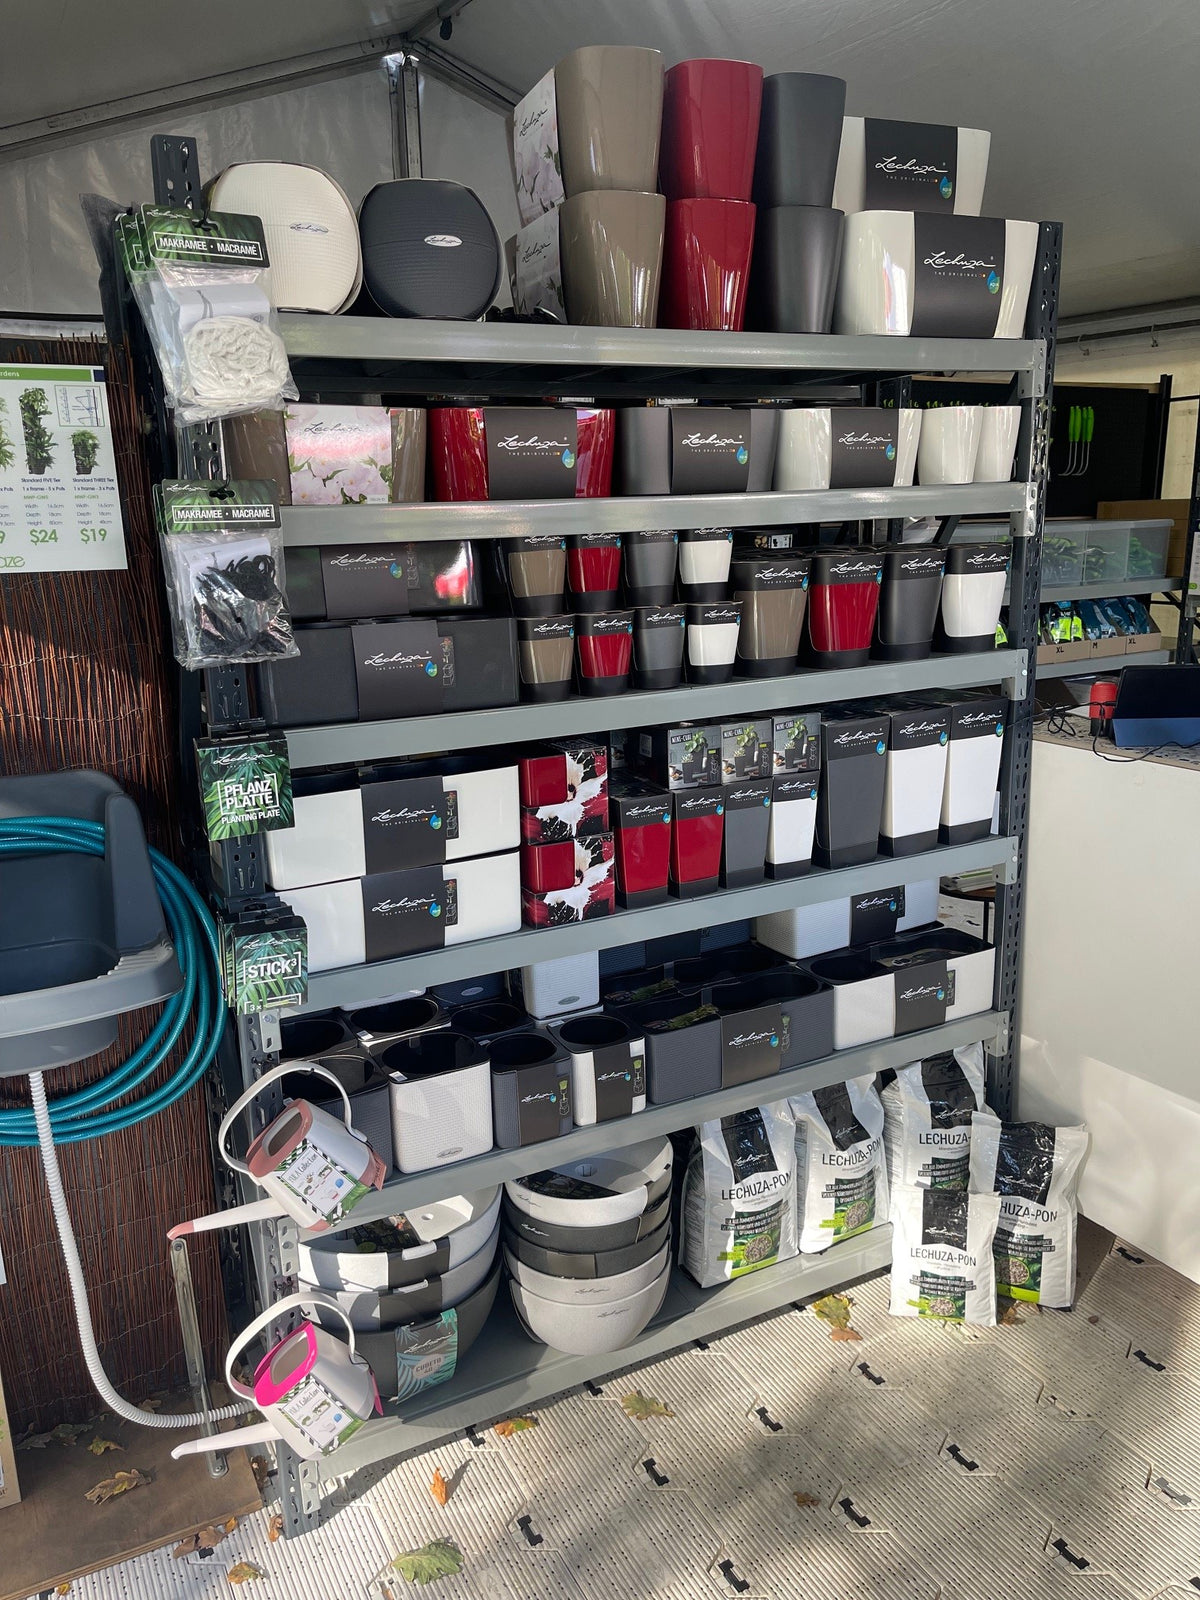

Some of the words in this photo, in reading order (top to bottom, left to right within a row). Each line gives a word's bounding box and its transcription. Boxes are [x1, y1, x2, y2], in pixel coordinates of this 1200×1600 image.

[875, 156, 948, 174] Lechuza
[159, 237, 208, 251] MAKRAMEE
[216, 242, 258, 256] MACRAMÉ
[923, 251, 997, 269] Lechuza
[497, 435, 570, 450] Lechuza
[681, 432, 745, 447] Lechuza
[838, 432, 893, 445] Lechuza
[177, 509, 223, 519] MAKRAMEE
[231, 507, 270, 518] MACRAMÉ
[29, 528, 59, 546] $24
[79, 527, 108, 545] $19
[330, 553, 396, 566] Lechuza
[755, 567, 809, 580] Lechuza
[829, 562, 883, 573] Lechuza
[1128, 637, 1137, 645] XL
[364, 651, 432, 666] Lechuza
[957, 711, 1003, 725] Lechuza
[899, 721, 947, 734] Lechuza
[833, 730, 885, 744] Lechuza
[223, 780, 273, 797] PFLANZ
[225, 791, 274, 810] PLATTE
[221, 812, 258, 824] PLANTING
[259, 808, 281, 819] PLATE
[371, 807, 437, 822] Lechuza
[371, 897, 437, 912] Lechuza
[822, 1137, 881, 1166] LECHUZA-PON
[721, 1170, 792, 1201] LECHUZA-PON
[910, 1247, 977, 1267] LECHUZA-PON
[415, 1357, 442, 1372] CUBETO
